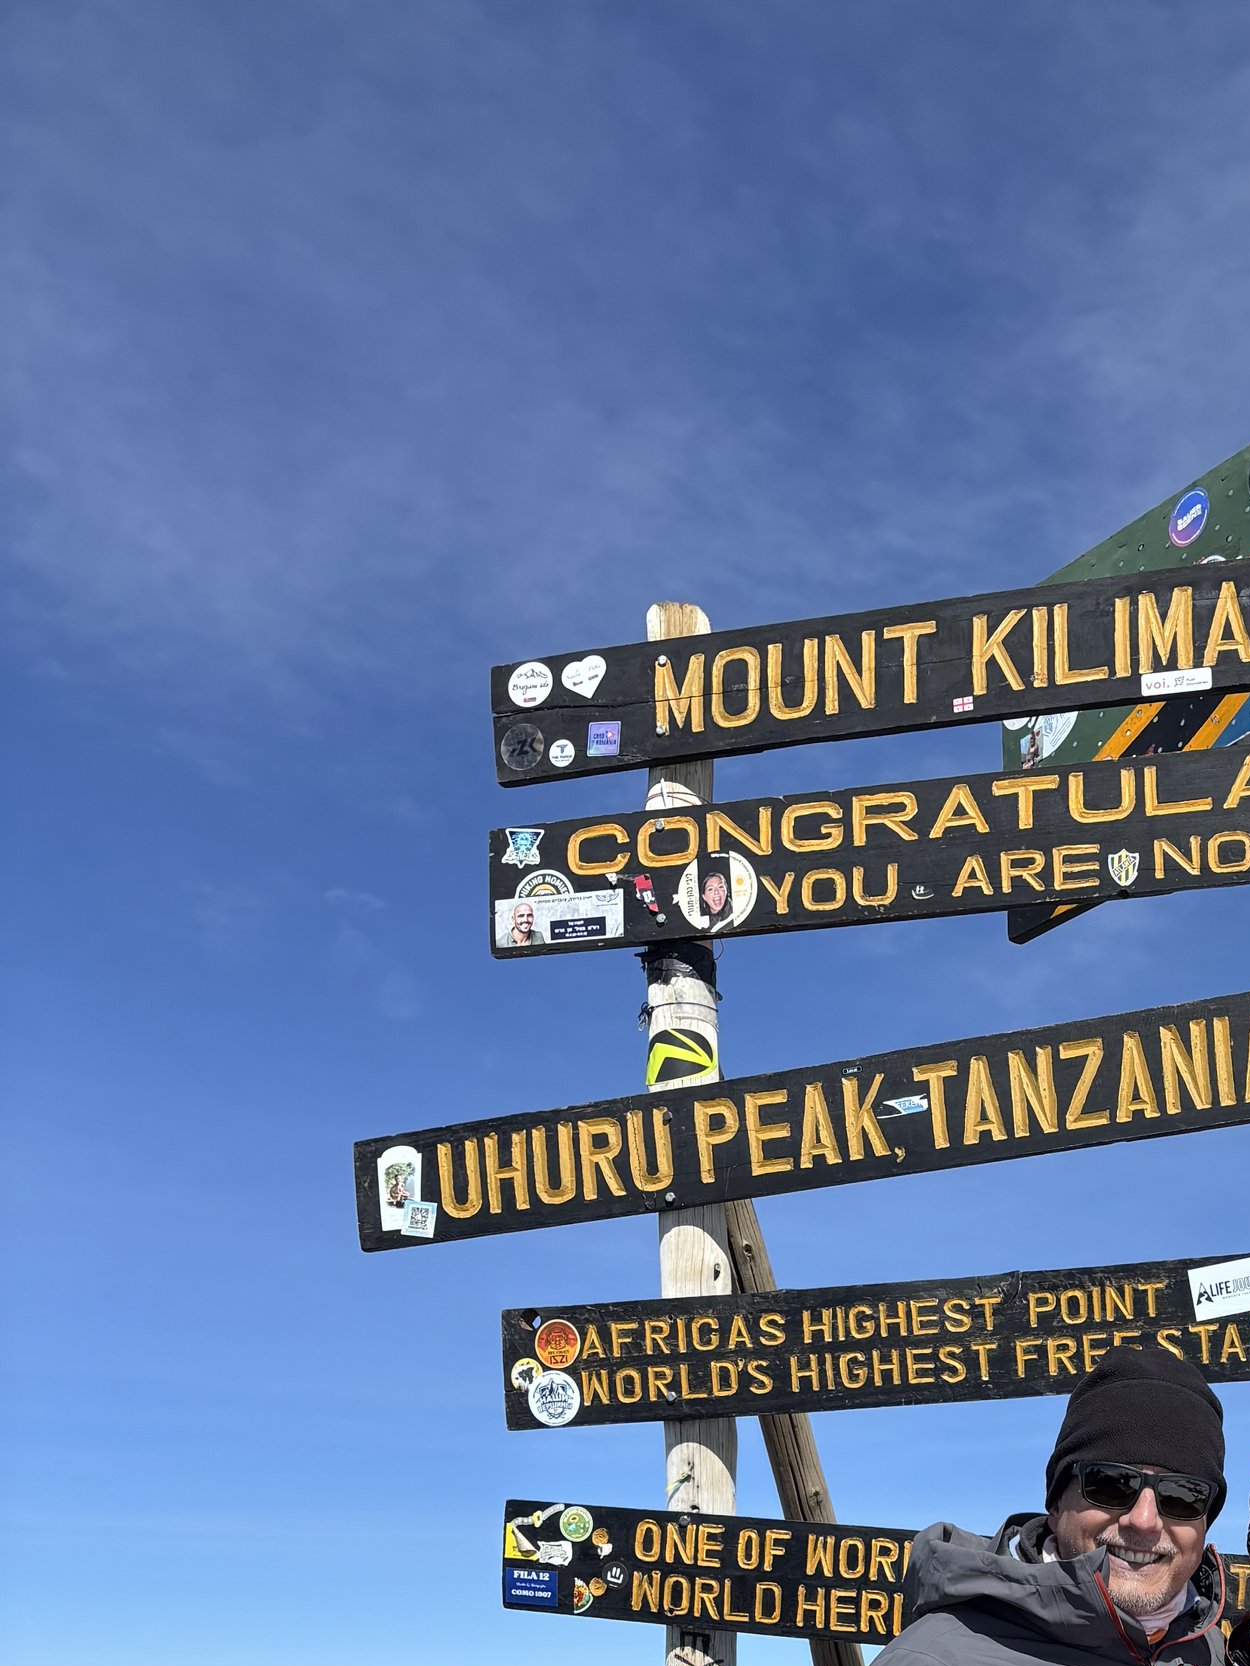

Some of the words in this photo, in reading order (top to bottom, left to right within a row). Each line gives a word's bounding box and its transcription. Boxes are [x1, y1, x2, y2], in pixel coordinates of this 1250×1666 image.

[655, 620, 936, 736] MOUNT
[1145, 678, 1171, 691] voi.
[520, 875, 544, 898] HIKING
[759, 862, 898, 915] YOU
[952, 843, 1101, 897] ARE
[436, 1106, 674, 1220] UHURU
[694, 1073, 906, 1185] PEAK,
[1210, 1280, 1232, 1295] LIFE
[582, 1313, 786, 1360] AFRICAS
[802, 1295, 1002, 1344] HIGHEST
[1028, 1281, 1165, 1328] POINT
[581, 1358, 774, 1406] WORLD'S
[790, 1341, 998, 1393] HIGHEST
[635, 1518, 726, 1569] ONE
[737, 1528, 792, 1572] OF
[511, 1588, 535, 1597] COMO
[513, 1570, 538, 1580] FILA
[539, 1571, 550, 1581] 12
[630, 1570, 784, 1625] WORLD
